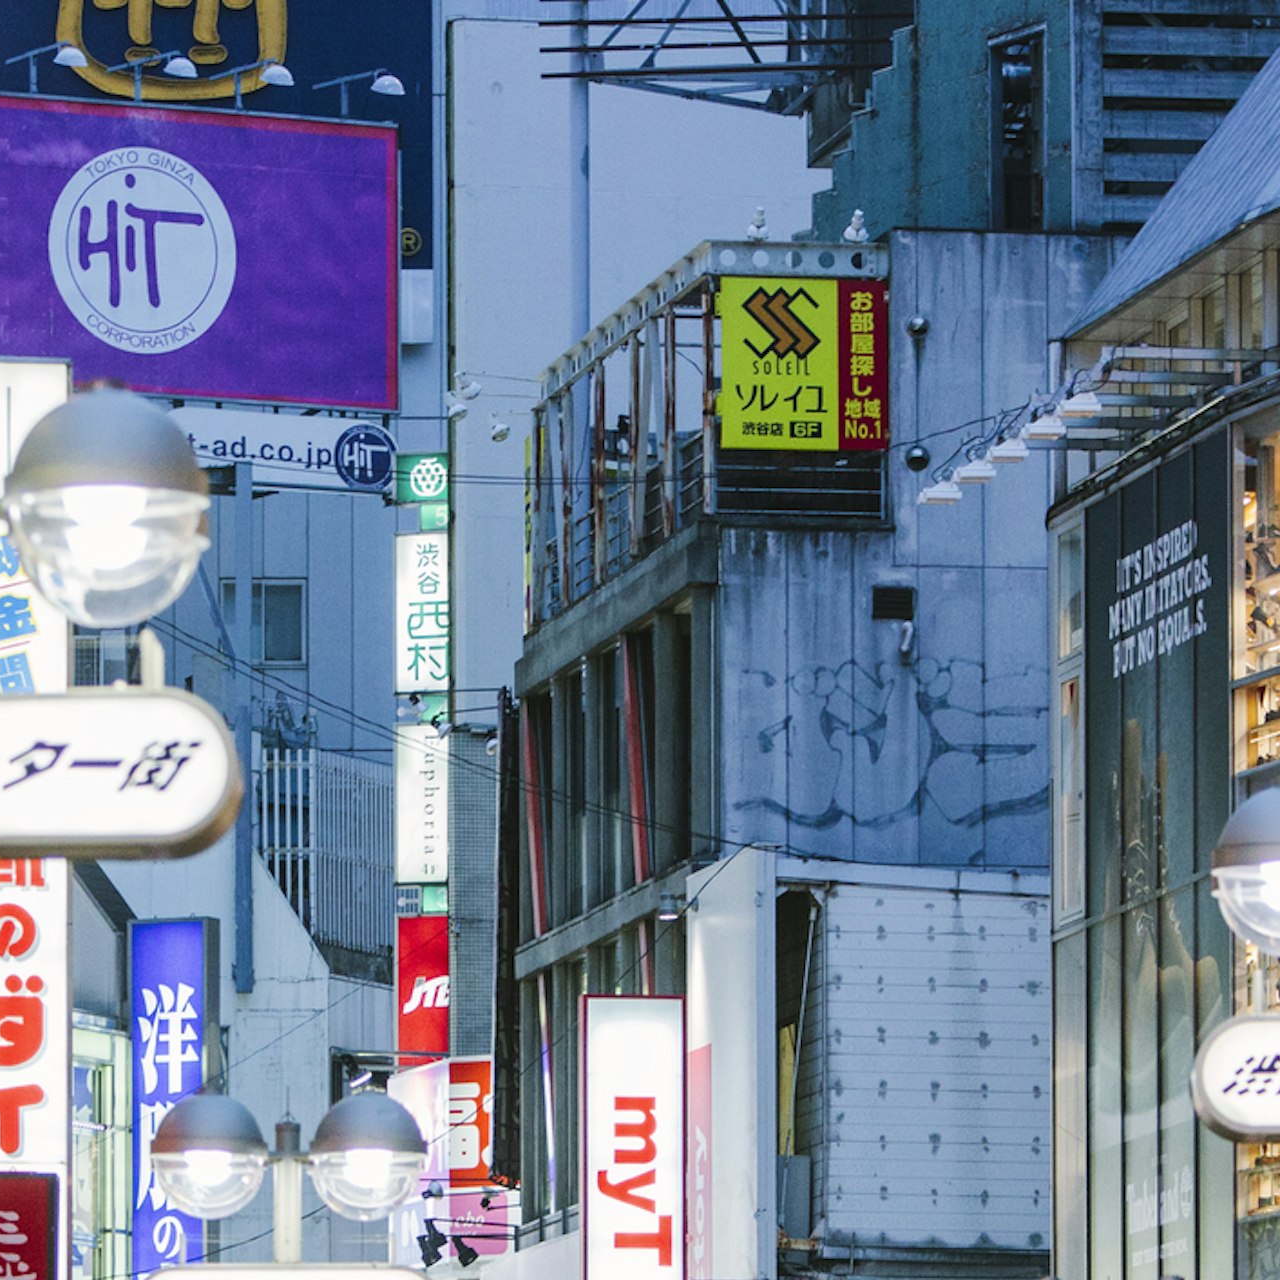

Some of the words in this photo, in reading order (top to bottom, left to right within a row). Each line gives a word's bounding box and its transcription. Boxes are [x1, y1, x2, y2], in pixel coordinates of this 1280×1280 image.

[84, 150, 139, 178] TOKYO
[147, 152, 196, 187] GINZA
[86, 313, 197, 349] CORPORATION
[849, 291, 875, 396] お部屋探し
[753, 357, 810, 376] SOLEIL
[735, 384, 828, 413] ソレイユ
[844, 399, 882, 419] 地域
[742, 421, 784, 436] 渋谷店
[793, 422, 820, 438] 6F
[844, 421, 882, 440] No.1
[406, 542, 449, 681] 渋谷西村
